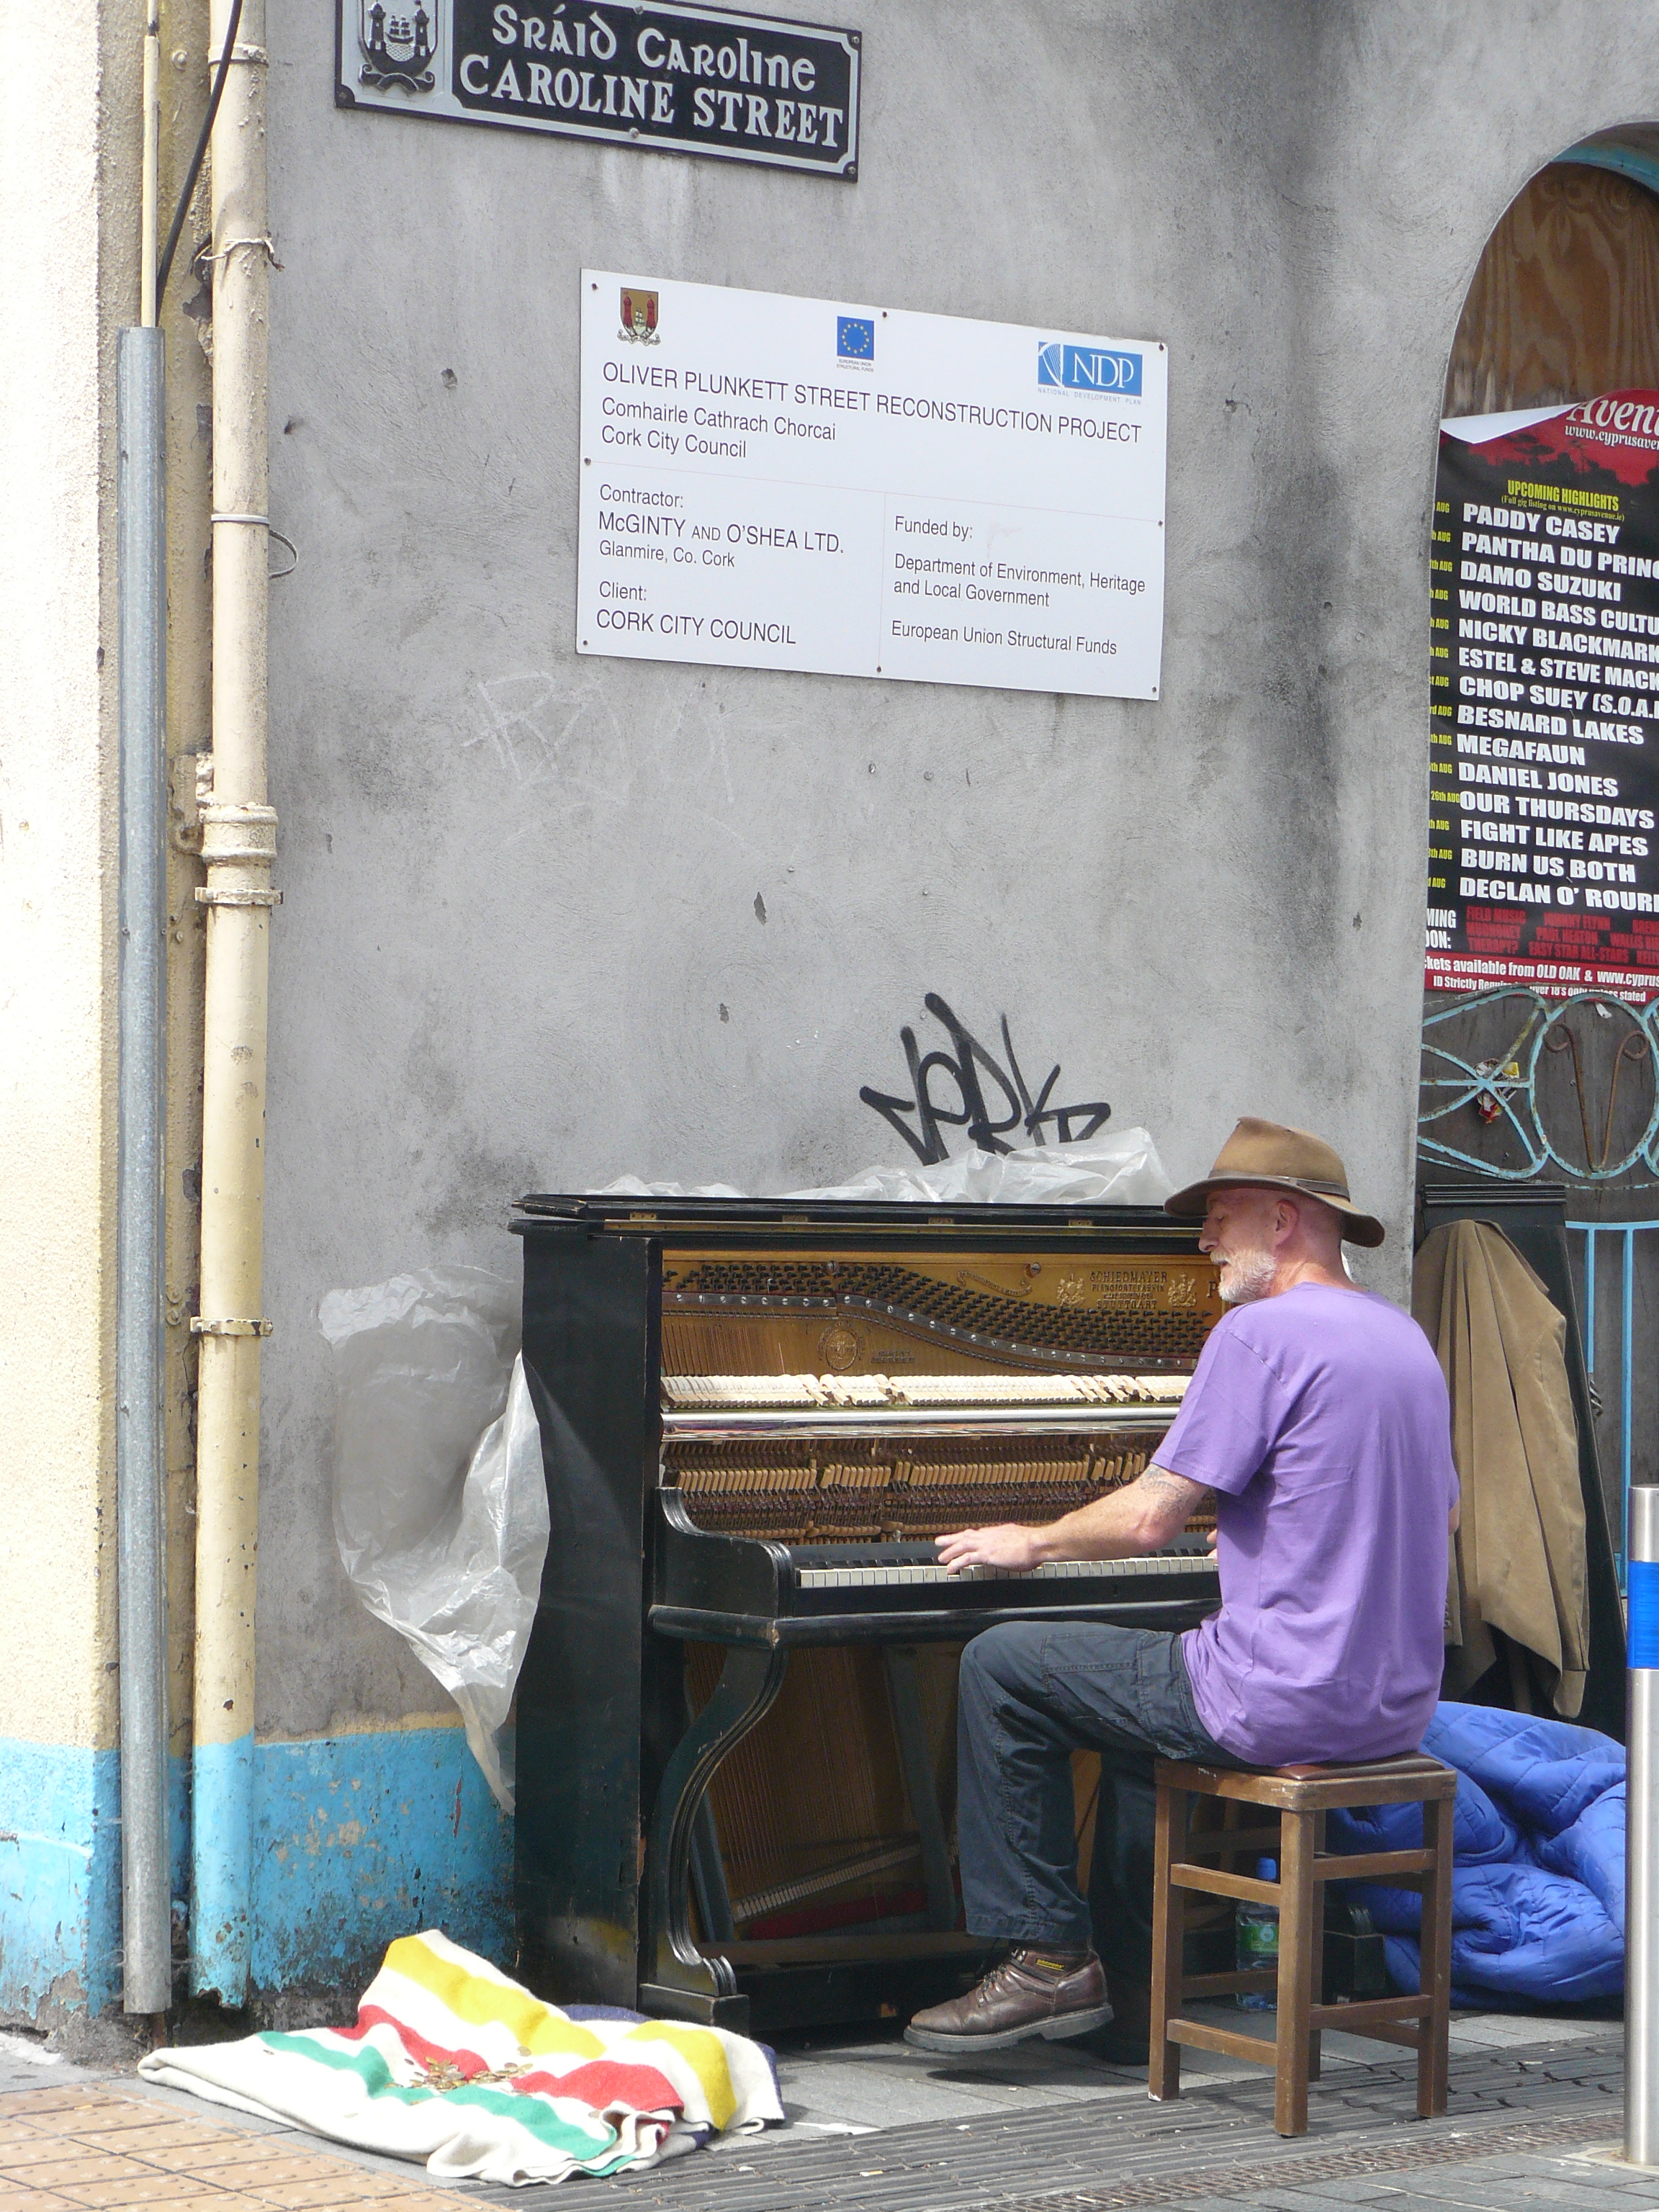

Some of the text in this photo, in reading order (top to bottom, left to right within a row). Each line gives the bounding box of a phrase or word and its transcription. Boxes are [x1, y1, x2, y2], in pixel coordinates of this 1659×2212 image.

[460, 55, 844, 148] CAROLINE STREET
[1072, 353, 1134, 388] NDP
[603, 362, 1141, 443] OLIVER PLUNKETT STREET RECONSTRUCTION PROJECT
[1038, 388, 1069, 397] NATIONAL
[1074, 392, 1120, 403] DEVELOPMENT
[602, 397, 836, 440] Comhairle Cathrach Chorcai
[601, 425, 746, 457] Cork City Council
[600, 484, 683, 508] Contractor:
[1437, 502, 1449, 513] AUG
[1507, 480, 1619, 511] UPCOMING HIGHLIGHTS
[1517, 498, 1527, 508] gig
[1529, 499, 1547, 511] listing
[598, 511, 844, 553] McGINTY AND O'SHEA LTD.
[895, 516, 973, 541] Funded by:
[1437, 531, 1451, 542] AUG
[1463, 503, 1620, 544] PADDY CASEY
[599, 540, 734, 567] Glanmire, Co. Cork
[1462, 531, 1555, 564] PANTHA
[1560, 546, 1592, 569] DU
[894, 554, 1146, 595] Department of Environment, Heritage
[1439, 561, 1452, 572] AUG
[599, 581, 647, 601] Client:
[894, 580, 1049, 607] and Local Government
[1460, 561, 1621, 601] DAMO SUZUKI
[1435, 590, 1448, 601] AUG
[1436, 619, 1449, 629] AUG
[1459, 589, 1659, 635] WORLD BASS CULTU
[597, 609, 796, 644] CORK CITY COUNCIL
[892, 621, 1117, 655] European Union Structural Funds
[1459, 619, 1527, 645] NICKY
[1435, 647, 1449, 658] AUG
[1459, 647, 1516, 673] ESTEL
[1521, 658, 1536, 675] &
[1540, 657, 1601, 683] STEVE
[1436, 676, 1449, 687] AUG
[1460, 676, 1524, 701] CHOP
[1529, 685, 1588, 710] SUEY
[1438, 705, 1452, 716] AUG
[1457, 705, 1644, 745] BESNARD LAKES
[1438, 734, 1452, 745] AUG
[1457, 734, 1586, 766] MEGAFAUN
[1438, 763, 1452, 774] AUG
[1459, 762, 1618, 797] DANIEL JONES
[1431, 791, 1460, 803] 26th AUG
[1460, 791, 1655, 829] OUR THURSDAYS
[1435, 819, 1449, 830] AUG
[1461, 819, 1530, 845] FIGHT
[1535, 827, 1584, 850] LIKE
[1588, 832, 1648, 856] APES
[1439, 849, 1452, 860] AUG
[1461, 848, 1636, 883] BURN US BOTH
[1431, 878, 1446, 888] AUG
[1460, 877, 1550, 904] DECLAN
[1557, 886, 1579, 905] O'
[1529, 941, 1552, 956] EASY
[1454, 959, 1506, 976] available
[1509, 963, 1534, 978] from
[1537, 964, 1556, 979] OLD
[1558, 967, 1581, 981] OAK
[1584, 970, 1593, 981] &
[1434, 976, 1443, 986] ID
[1444, 976, 1476, 990] Strictly
[1619, 991, 1645, 1002] stated
[1089, 1271, 1168, 1282] SCHIEDMAYER
[1097, 1299, 1158, 1309] STUTTGART
